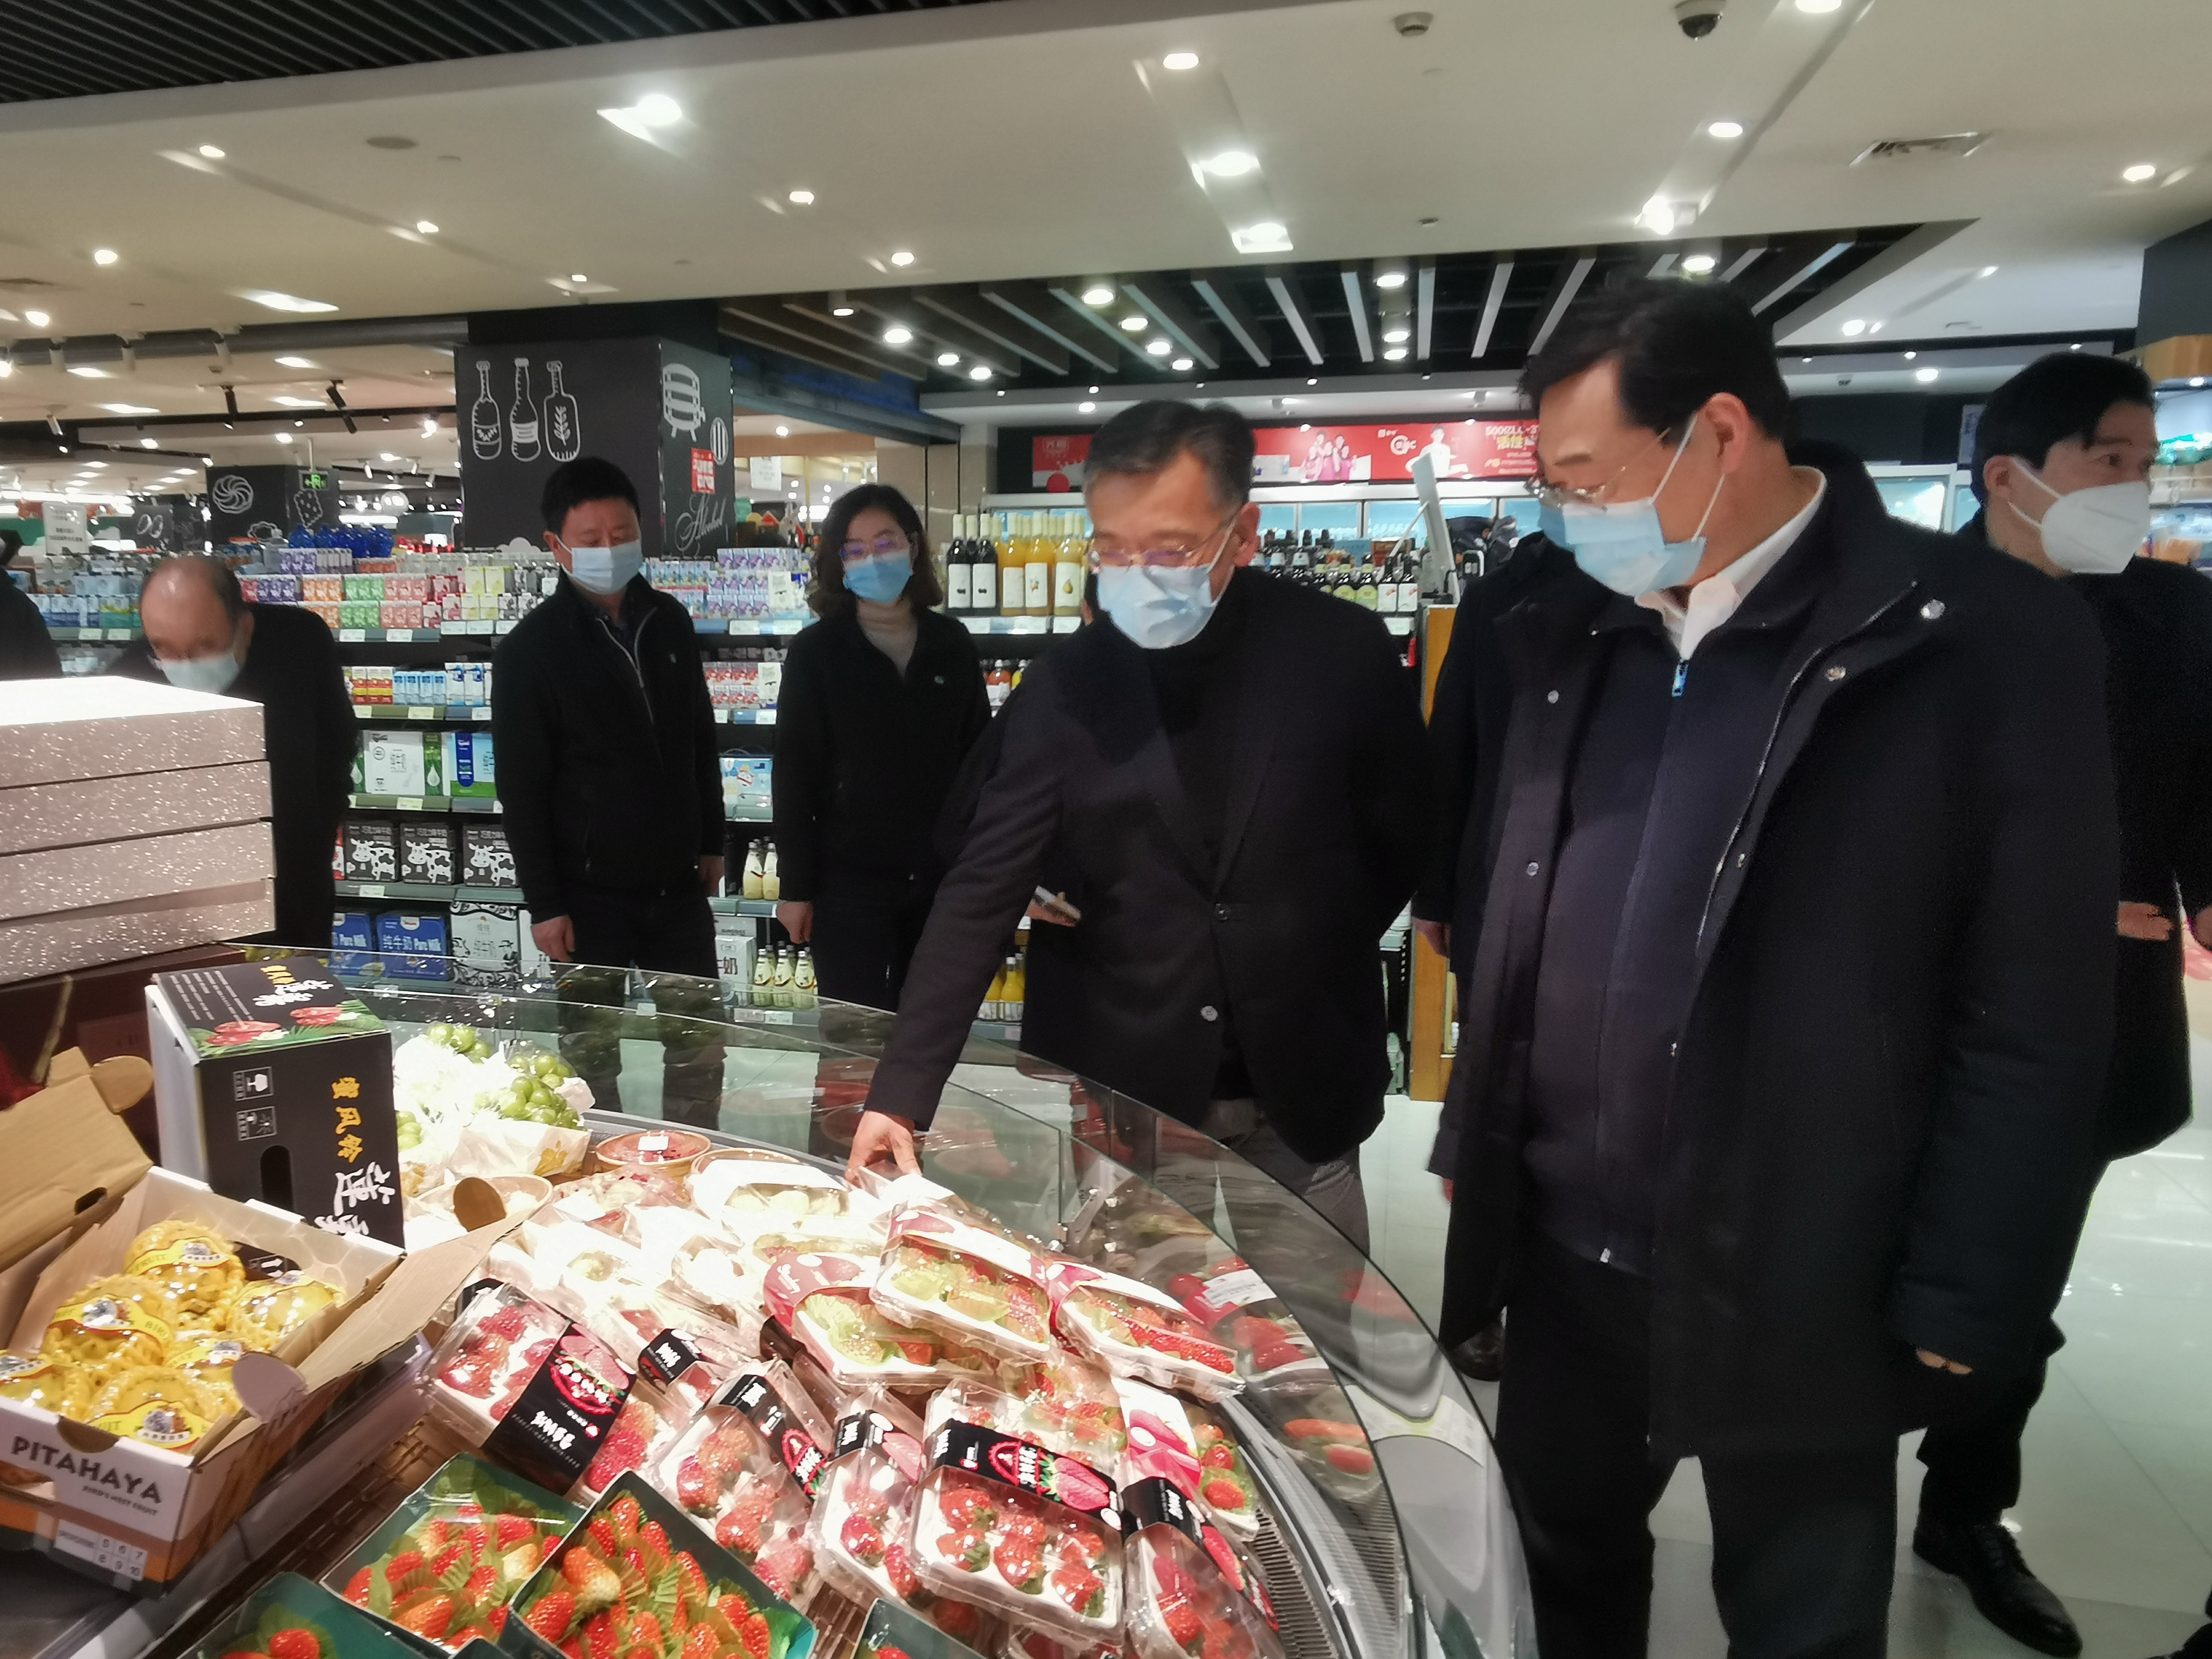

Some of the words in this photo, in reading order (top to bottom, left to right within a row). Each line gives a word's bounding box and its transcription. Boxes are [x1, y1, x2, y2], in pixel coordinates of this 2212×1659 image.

[331, 1077, 363, 1163] 蜜风铃
[11, 1436, 162, 1504] PITAHAYA
